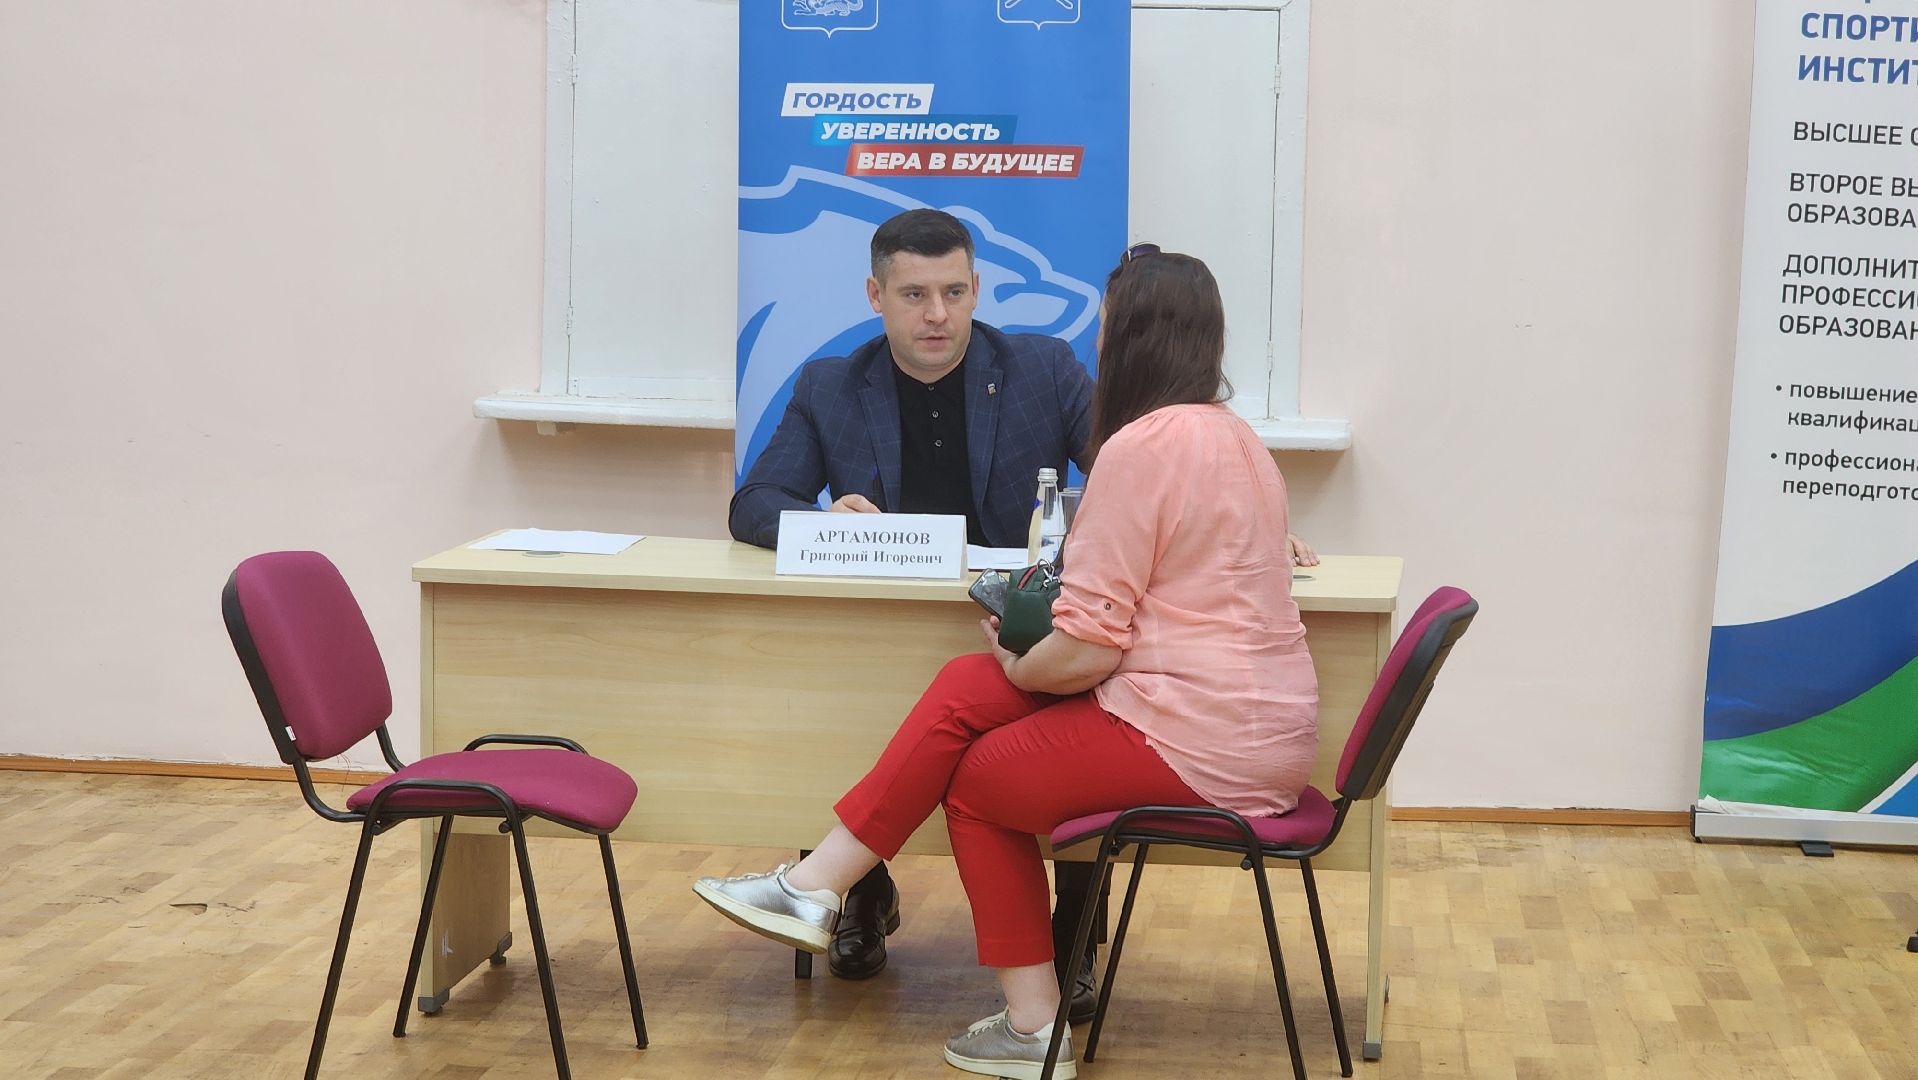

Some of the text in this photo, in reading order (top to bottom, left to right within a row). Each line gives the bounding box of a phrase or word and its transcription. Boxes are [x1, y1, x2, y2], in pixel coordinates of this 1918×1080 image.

[792, 92, 922, 112] ГОРДОСТЬ
[820, 122, 1001, 141] УВЕРЕННОСТЬ
[1793, 121, 1903, 146] ВЫСШЕЕ
[857, 152, 1075, 174] ВЕРА В БУДУЩЕЕ
[1790, 172, 1883, 196] ВТОРОЕ
[1787, 203, 1917, 228] ОБРАЗОВА
[1783, 254, 1918, 279] ДОПОЛНИТ
[1781, 284, 1918, 310] ПРОФЕССИ
[1779, 315, 1918, 341] ОБРАЗОВАН
[1789, 384, 1918, 404] повышение
[1785, 448, 1918, 472] профессион
[814, 530, 931, 545] АРТАМОНОВ
[800, 549, 943, 567] Григорий Игоревич
